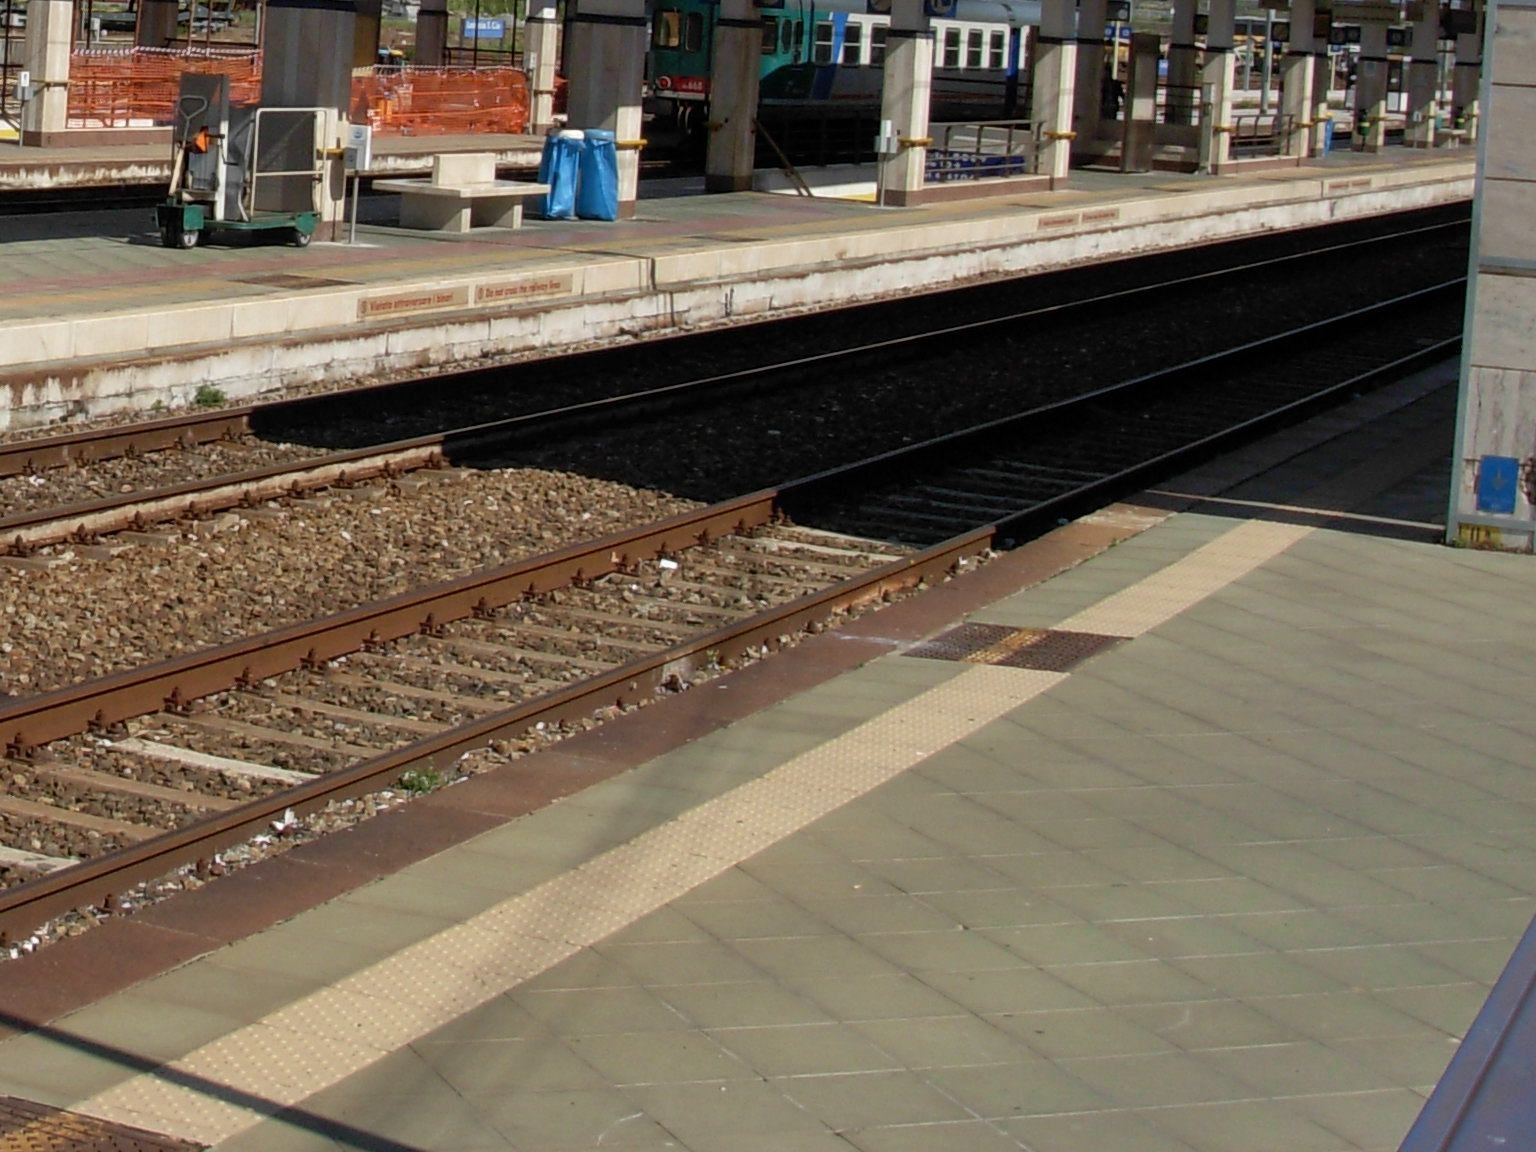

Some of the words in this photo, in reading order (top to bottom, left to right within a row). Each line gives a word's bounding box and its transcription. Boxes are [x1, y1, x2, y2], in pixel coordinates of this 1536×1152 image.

[486, 287, 494, 297] Do
[494, 287, 504, 296] not
[505, 287, 518, 295] cross
[519, 285, 527, 293] the
